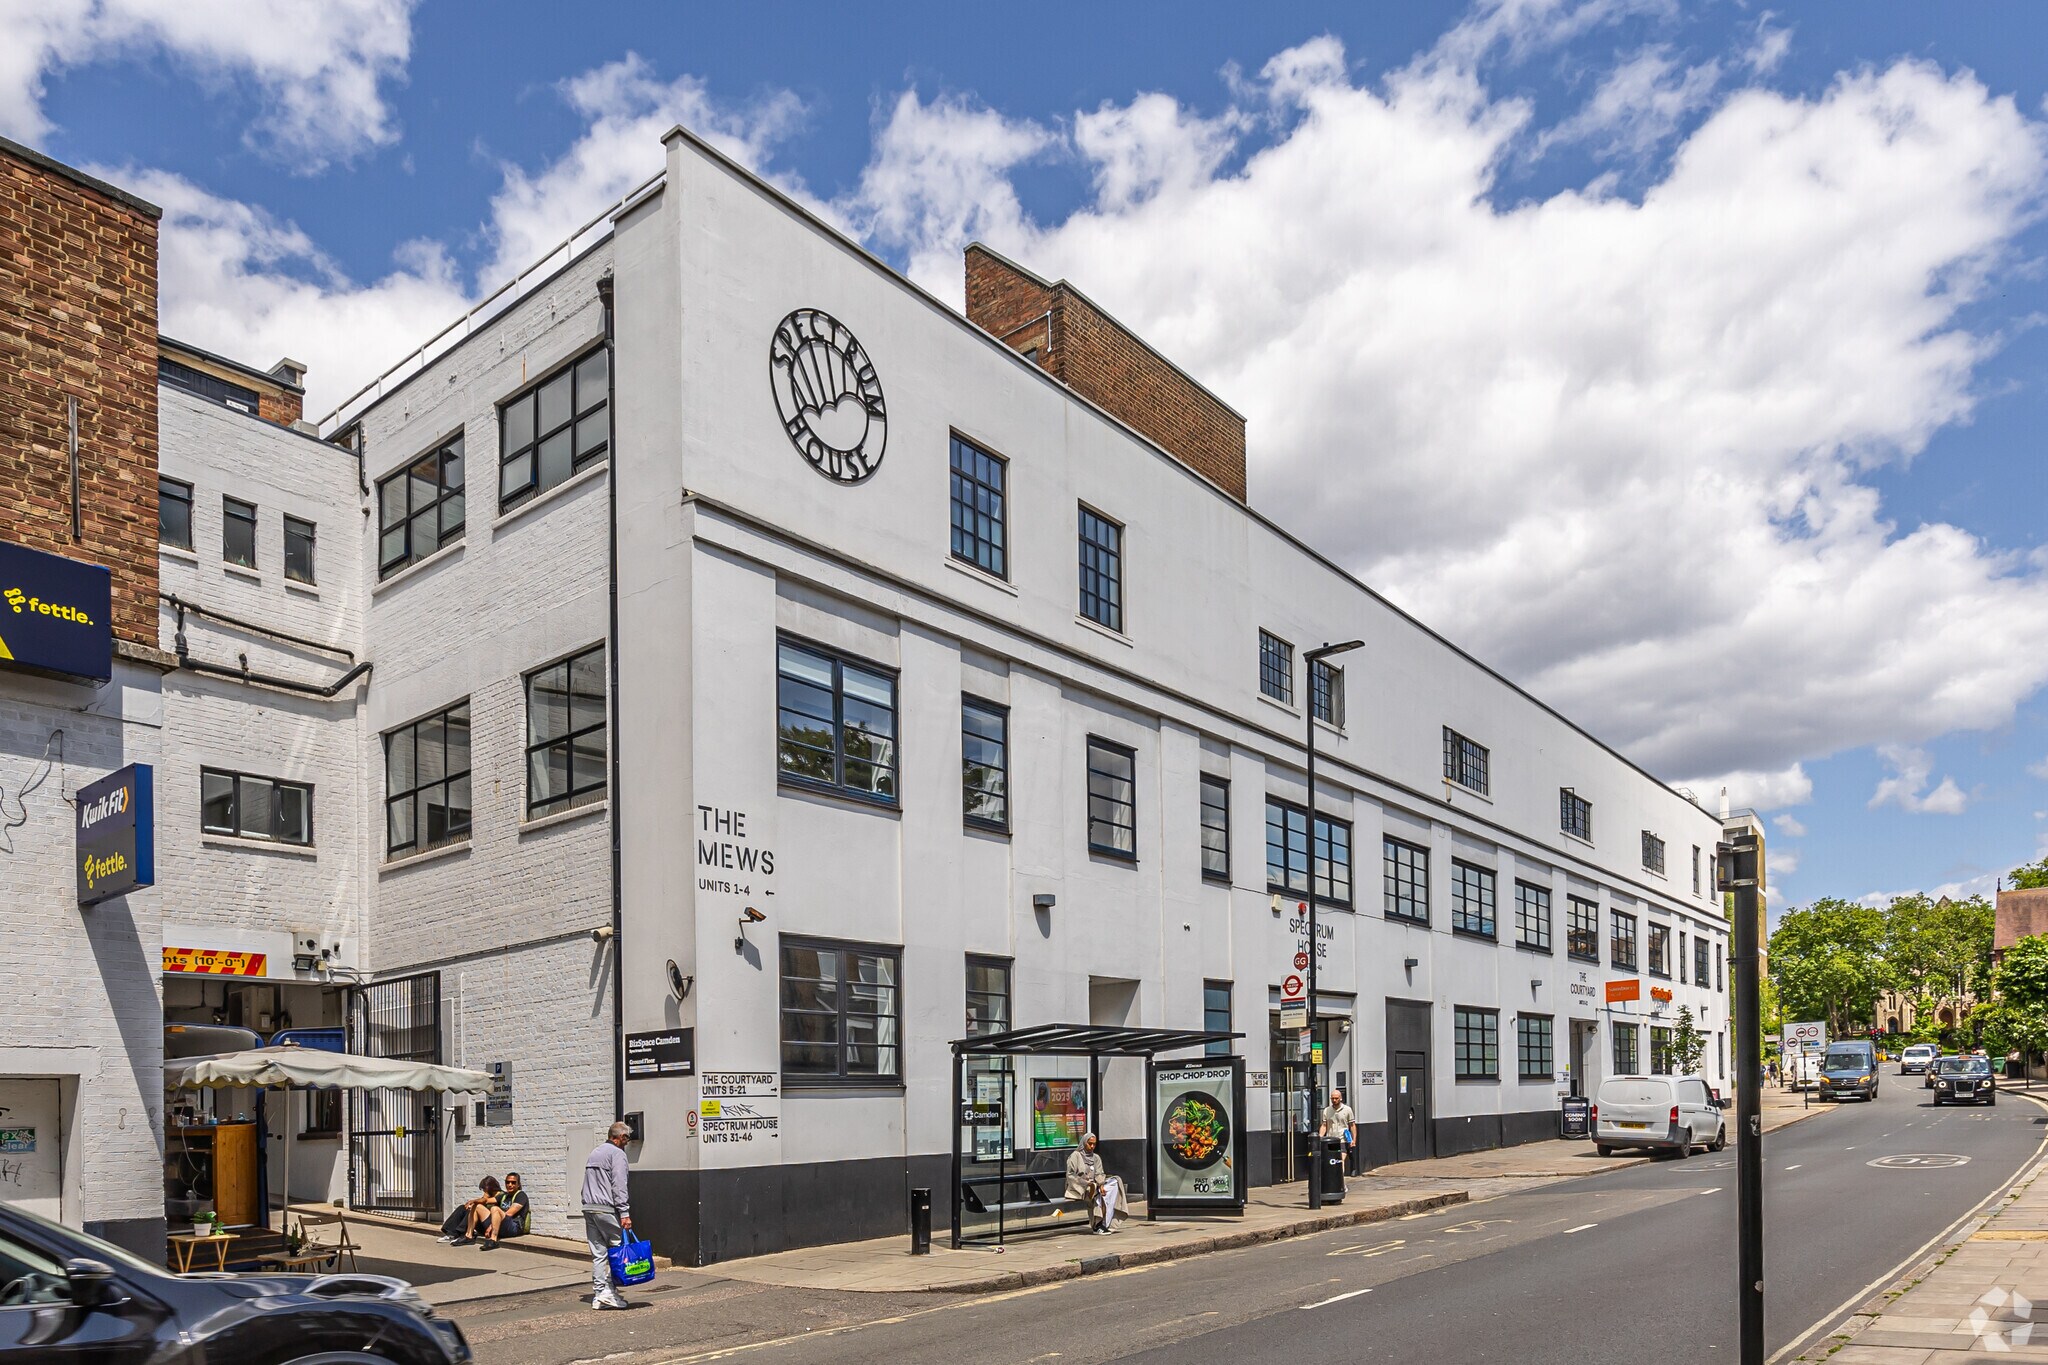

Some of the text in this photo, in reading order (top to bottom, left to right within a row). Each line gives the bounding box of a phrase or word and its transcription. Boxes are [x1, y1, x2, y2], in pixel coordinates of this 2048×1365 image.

[772, 312, 886, 418] SPECTRUM
[786, 413, 877, 480] HOUSE
[28, 597, 94, 626] fettle.
[697, 804, 746, 838] THE
[698, 839, 774, 876] MEWS
[96, 851, 128, 880] fettle.
[698, 878, 751, 897] UNITS 1-4
[1289, 917, 1334, 941] SPECRUM
[1297, 938, 1327, 958] HOSE
[1294, 957, 1307, 966] GG
[1579, 971, 1587, 983] THE
[1570, 983, 1596, 998] COURTYARD
[655, 1036, 681, 1046] Camden
[702, 1074, 773, 1085] THE COURTYARD
[702, 1085, 747, 1095] UNITS 5-21
[1051, 1093, 1070, 1102] 2025
[973, 1110, 999, 1119] Camden
[702, 1119, 778, 1132] SPECTRUM HOUSE
[702, 1132, 753, 1144] UNITS 31-46
